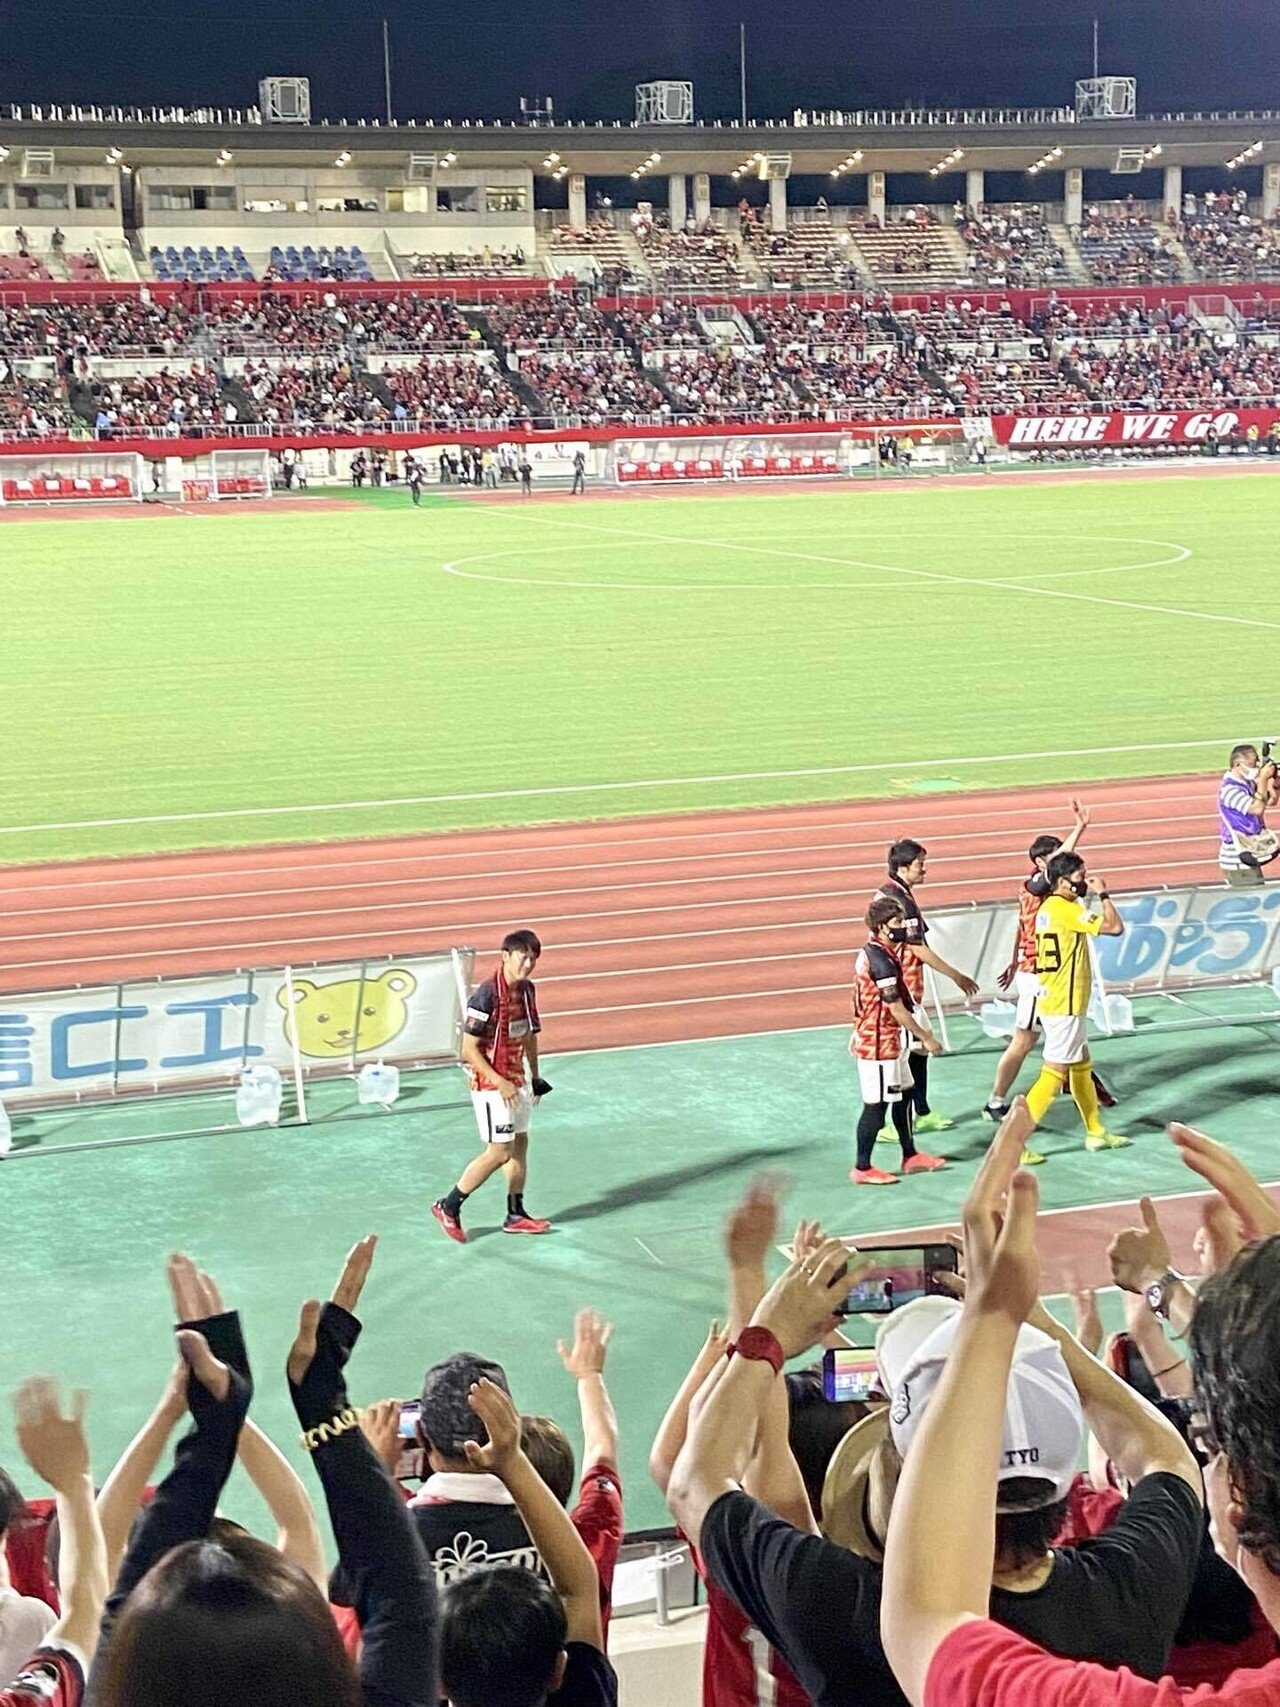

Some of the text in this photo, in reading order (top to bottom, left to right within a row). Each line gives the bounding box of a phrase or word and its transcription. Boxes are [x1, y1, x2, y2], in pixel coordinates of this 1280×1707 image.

[1009, 416, 1111, 443] HERE
[1121, 414, 1178, 440] WE
[1183, 412, 1239, 438] GO
[1004, 1447, 1039, 1465] TYO
